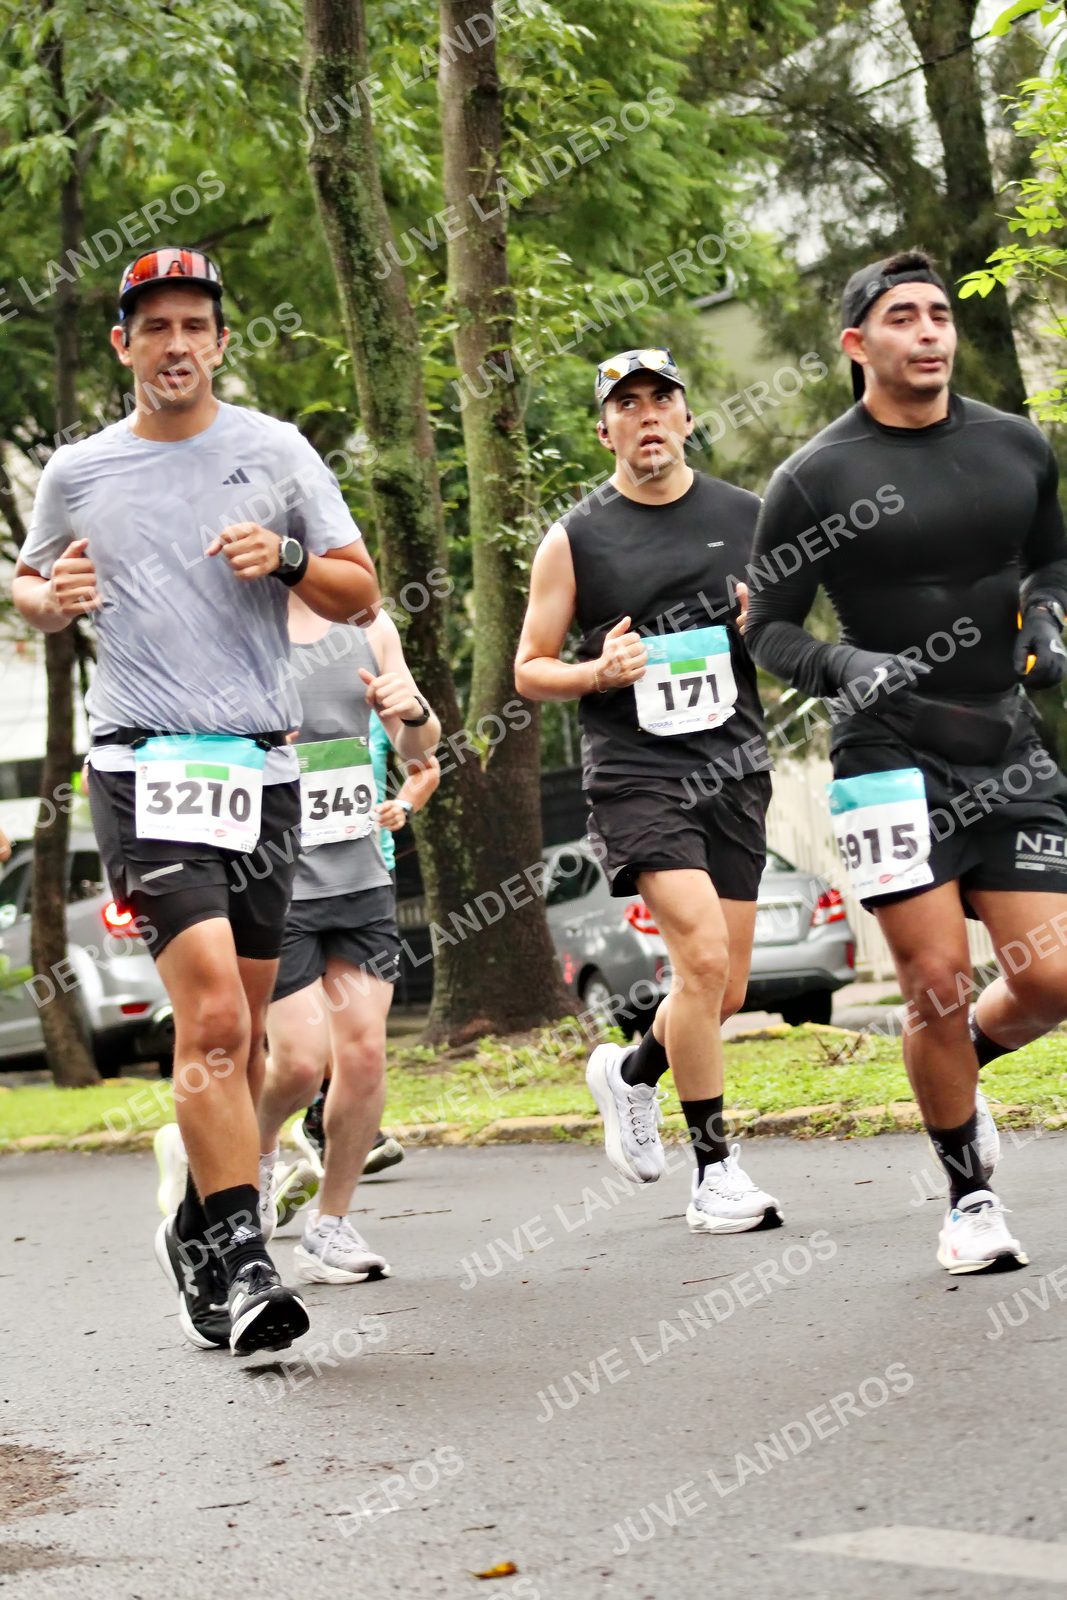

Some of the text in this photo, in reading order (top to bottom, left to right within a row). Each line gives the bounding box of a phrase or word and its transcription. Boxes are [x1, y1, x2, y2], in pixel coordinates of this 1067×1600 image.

[658, 674, 720, 711] 171
[146, 781, 251, 822] 3210
[308, 784, 372, 820] 349
[1016, 831, 1067, 857] NI
